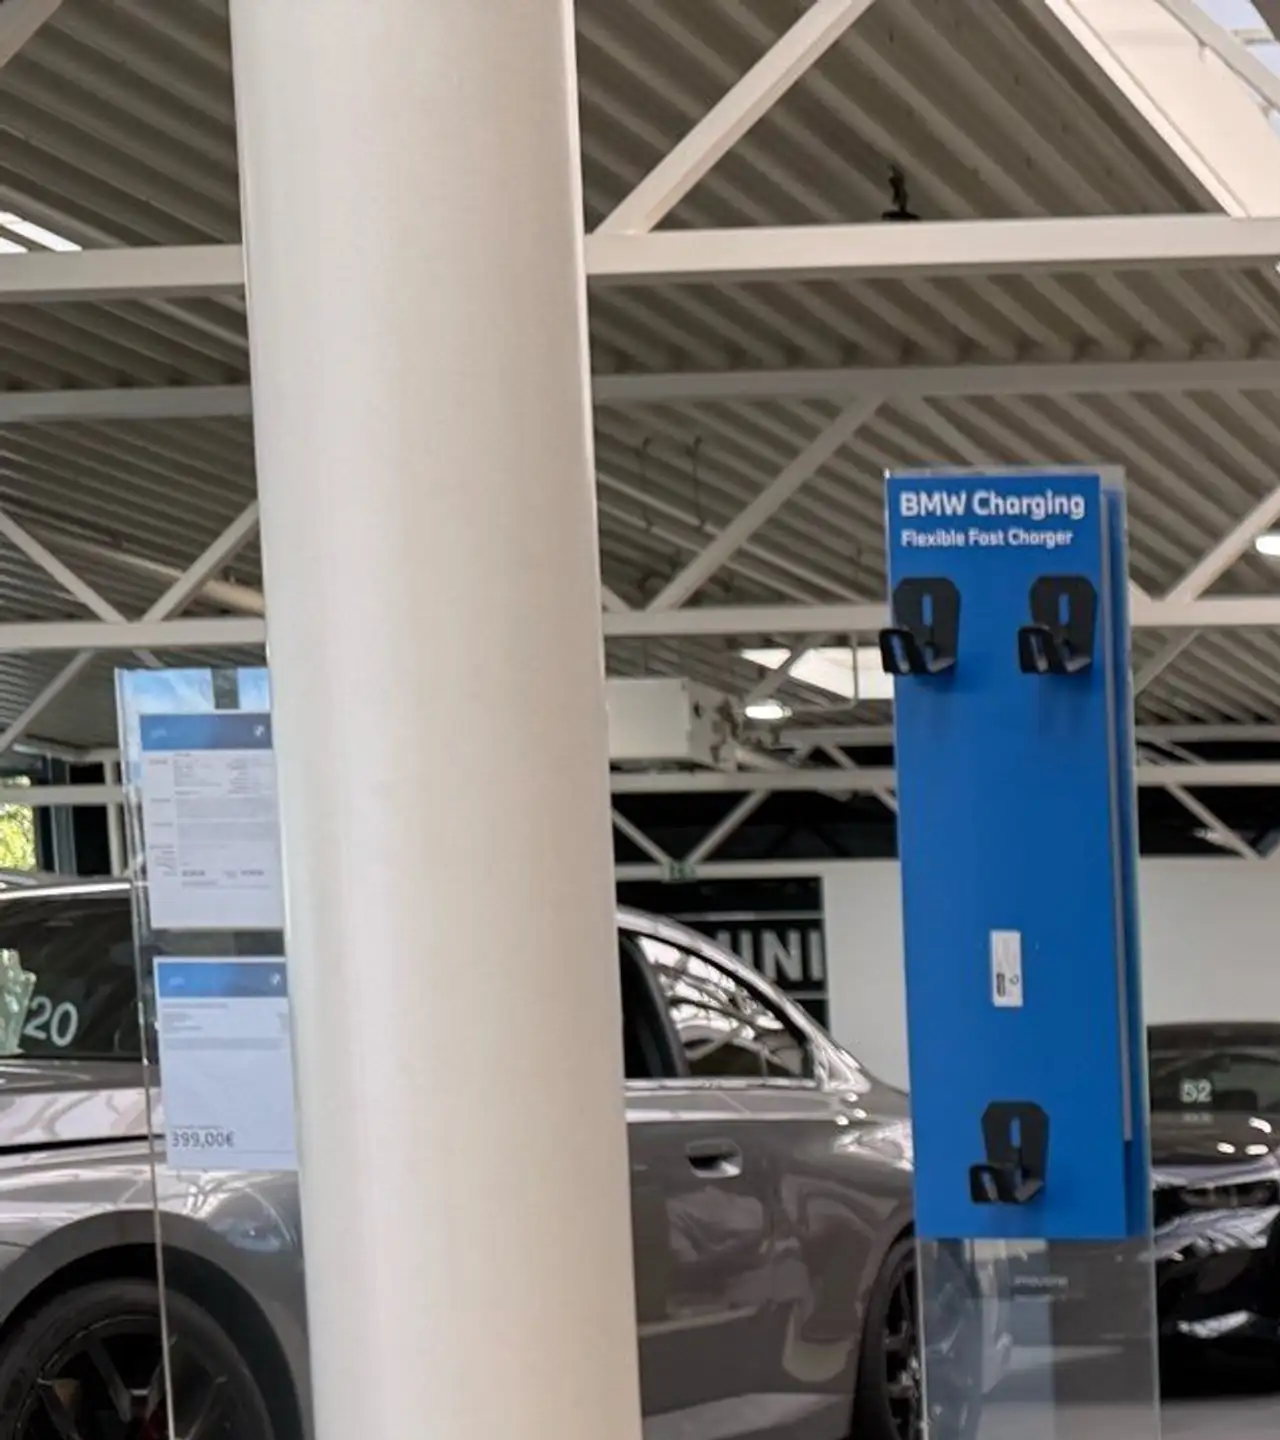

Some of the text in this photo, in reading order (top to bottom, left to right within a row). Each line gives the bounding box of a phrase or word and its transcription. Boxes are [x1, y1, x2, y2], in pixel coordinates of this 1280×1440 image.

[900, 489, 1086, 520] BMW Charging
[901, 528, 1073, 549] Flexible Fast Charger
[24, 995, 79, 1048] 20
